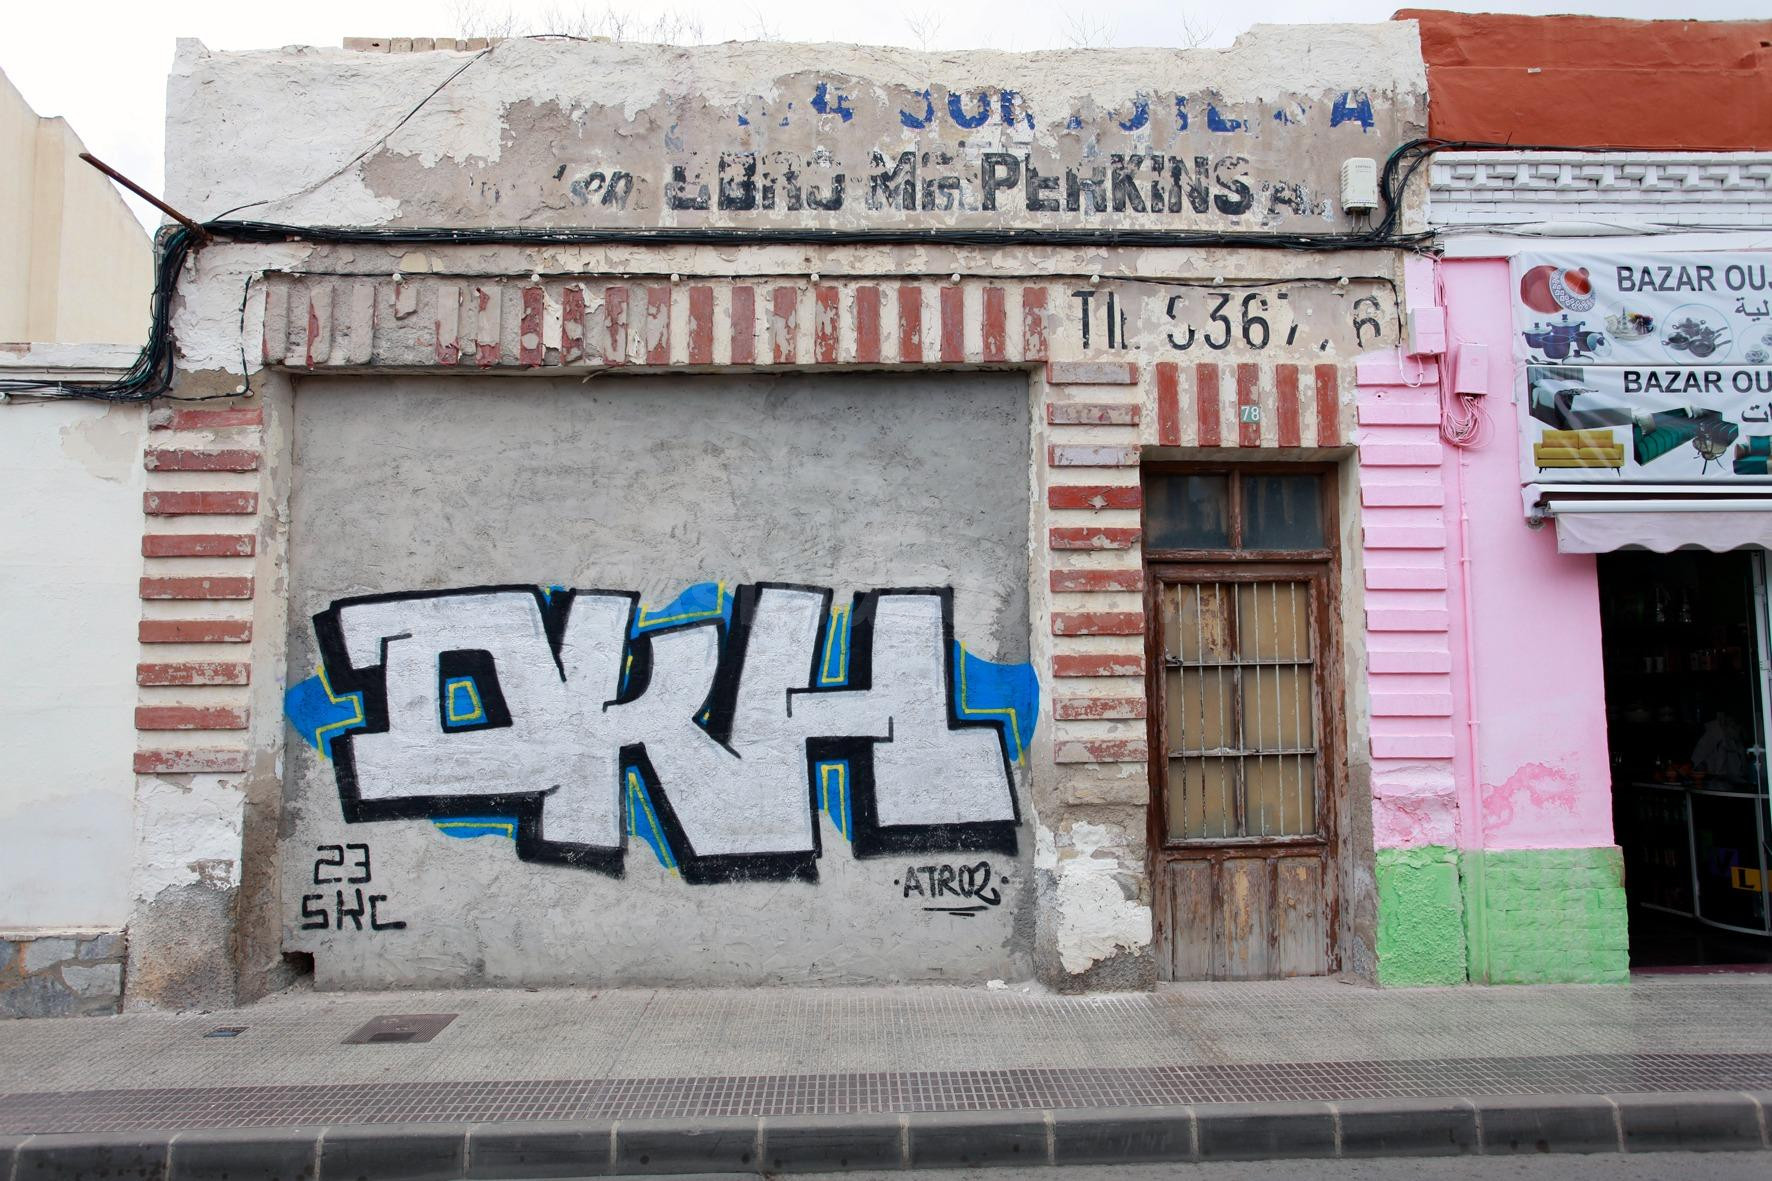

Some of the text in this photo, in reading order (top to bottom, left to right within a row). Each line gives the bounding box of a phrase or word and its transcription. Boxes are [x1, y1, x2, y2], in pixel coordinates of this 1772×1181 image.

[1616, 264, 1772, 292] BAZAR OU
[1624, 370, 1723, 393] BAZAR
[1241, 406, 1260, 421] 78
[314, 843, 371, 885] 23
